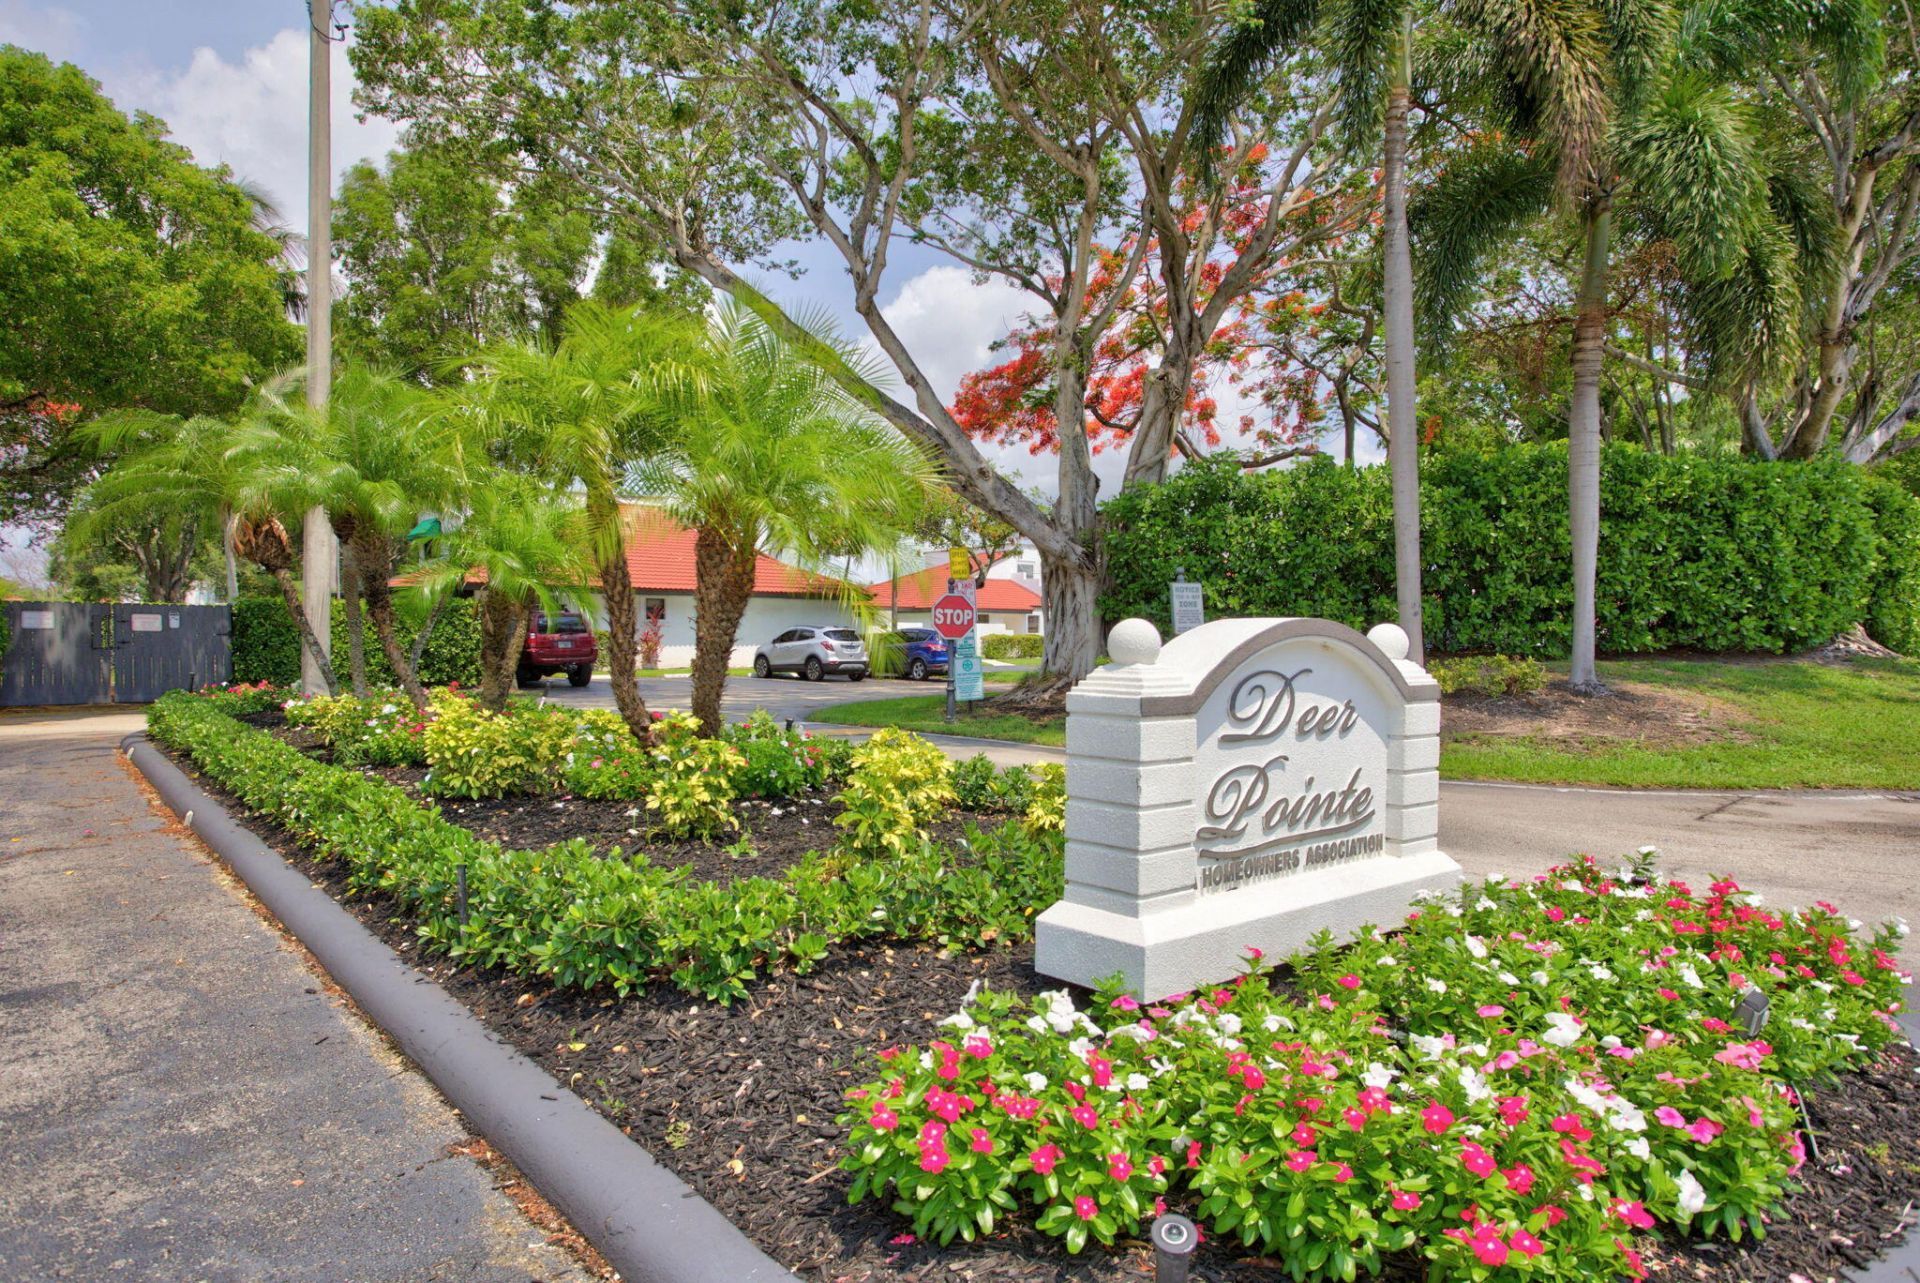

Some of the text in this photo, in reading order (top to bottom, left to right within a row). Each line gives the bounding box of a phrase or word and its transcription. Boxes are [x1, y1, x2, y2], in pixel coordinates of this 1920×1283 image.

[935, 609, 972, 625] STOP
[1217, 668, 1360, 744] Deer
[1196, 755, 1375, 842] Pointe
[1202, 834, 1384, 888] HOMEOWNERS ASSOCIATION
